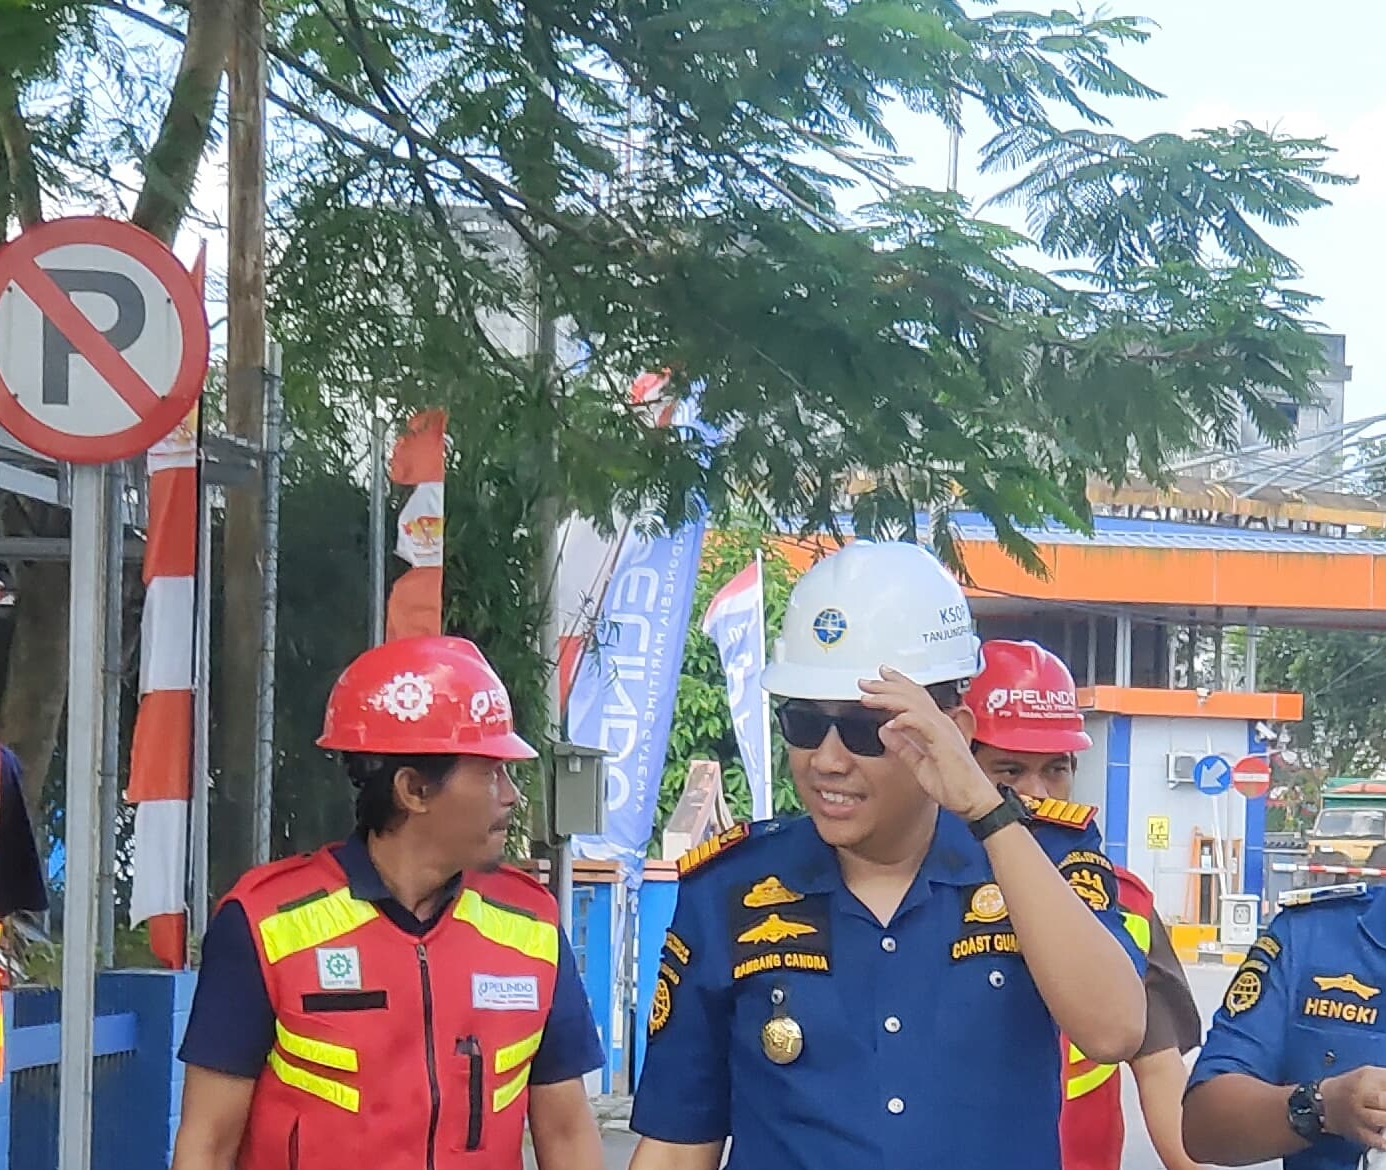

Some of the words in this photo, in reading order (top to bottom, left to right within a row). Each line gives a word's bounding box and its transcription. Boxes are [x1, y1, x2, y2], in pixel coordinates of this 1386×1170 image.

[42, 268, 146, 406] P
[952, 935, 992, 959] COAST
[994, 933, 1020, 953] GUA
[783, 953, 830, 972] CANDRA
[1304, 997, 1379, 1025] HENGKI
